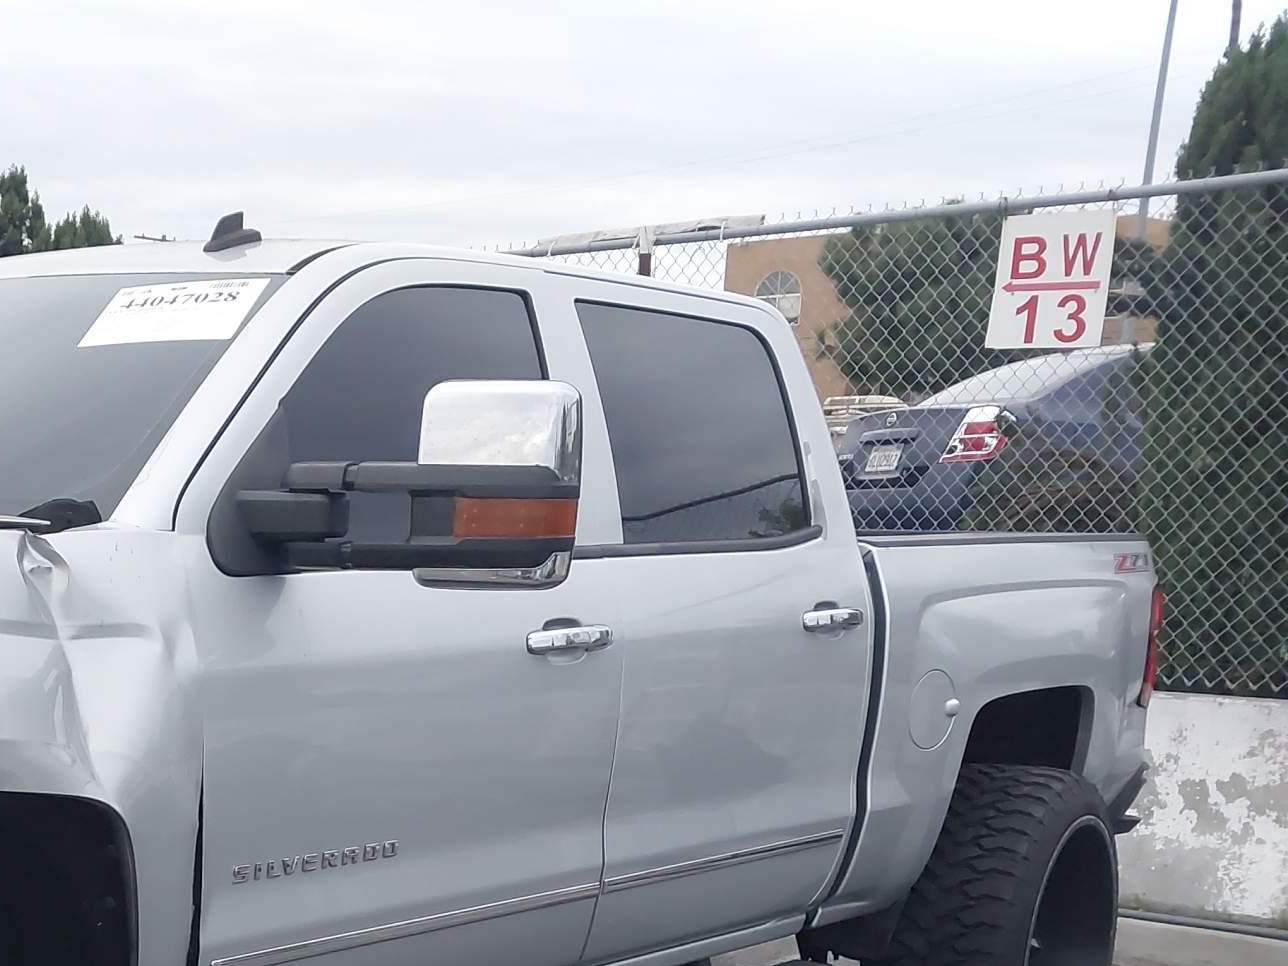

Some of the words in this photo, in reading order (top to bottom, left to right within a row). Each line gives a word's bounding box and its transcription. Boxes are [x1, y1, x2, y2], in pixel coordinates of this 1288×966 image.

[120, 291, 241, 309] 44047028
[1015, 293, 1087, 344] 13
[1112, 553, 1150, 574] Z71
[231, 839, 400, 885] SILVERADO
